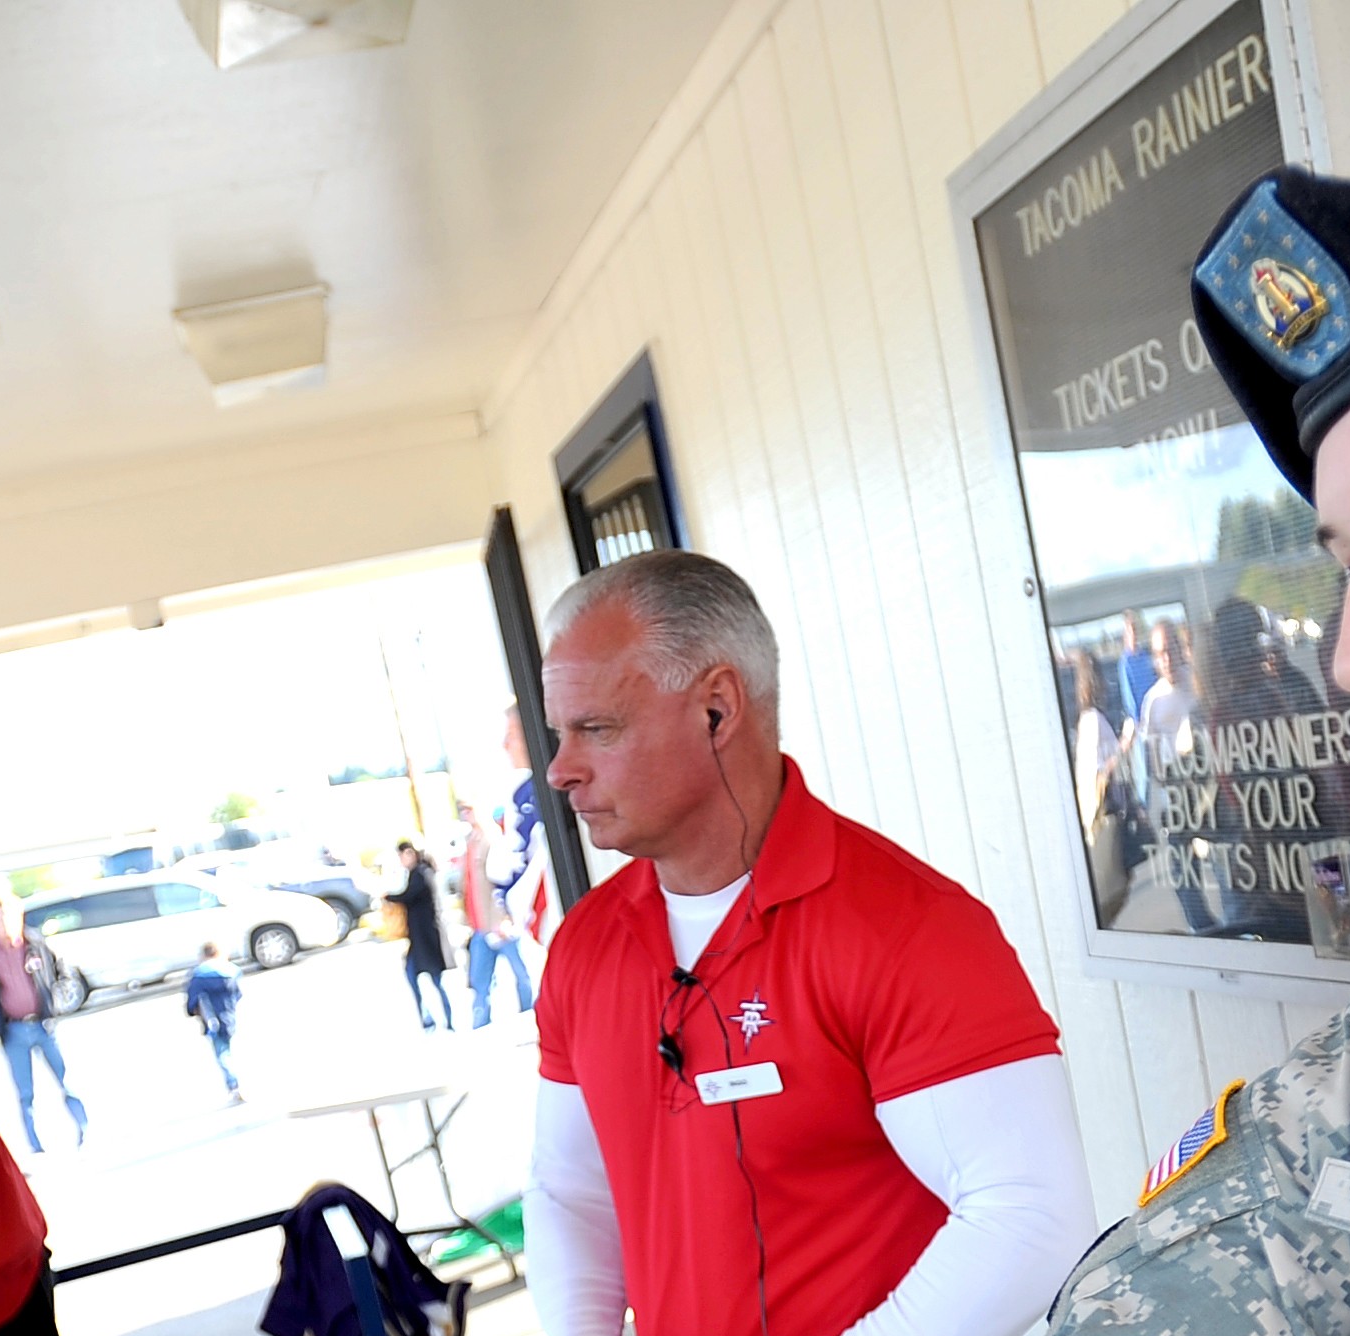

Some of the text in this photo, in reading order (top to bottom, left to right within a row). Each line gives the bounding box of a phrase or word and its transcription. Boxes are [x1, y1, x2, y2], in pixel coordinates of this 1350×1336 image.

[1016, 34, 1271, 257] TACOMA RAINIER
[1052, 338, 1169, 432] TICKETS
[1180, 318, 1212, 374] O
[1166, 775, 1320, 833] BUY YOUR
[1143, 842, 1257, 891] TICKETS
